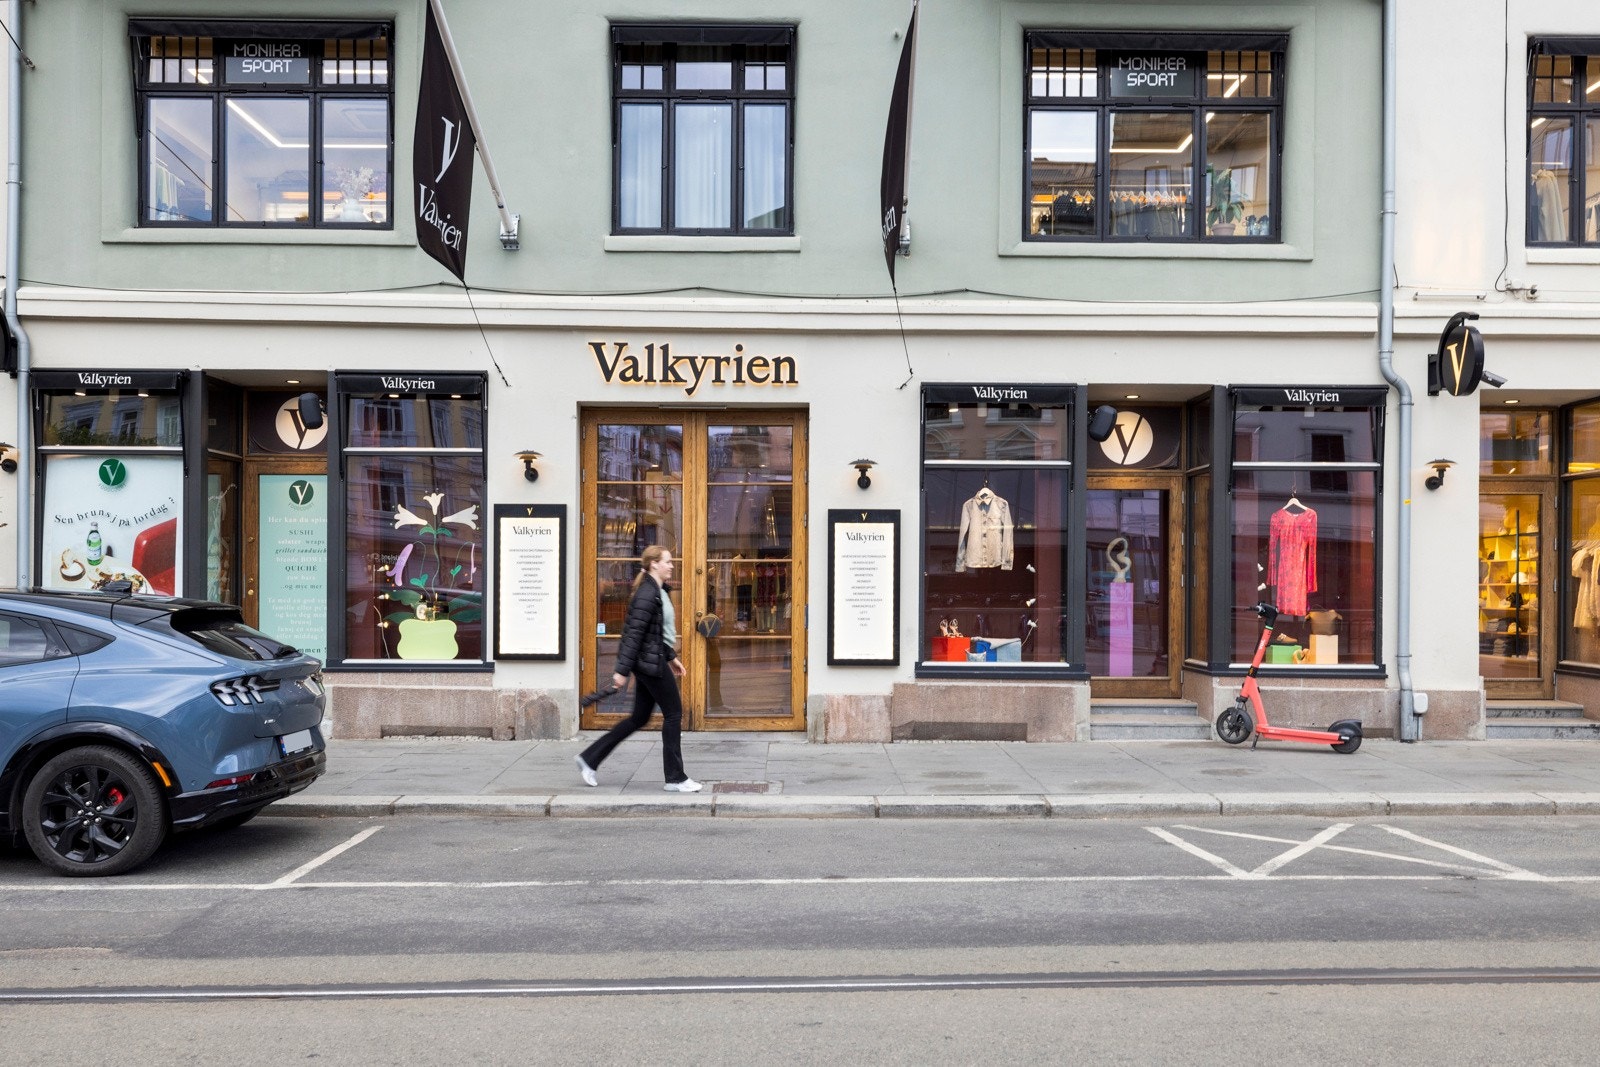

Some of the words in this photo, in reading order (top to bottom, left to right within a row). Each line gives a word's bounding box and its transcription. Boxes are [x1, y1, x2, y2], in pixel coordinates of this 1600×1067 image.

[233, 43, 301, 57] MONIKER
[242, 59, 292, 73] SPORT
[1118, 57, 1186, 70] MONIKER
[1127, 73, 1177, 86] SPORT
[588, 341, 799, 396] Valkyrien
[77, 372, 132, 388] Valkyrien
[381, 376, 435, 392] Valkyrien
[972, 386, 1028, 402] Valkyrien
[1283, 389, 1340, 405] Valkyrien
[512, 526, 552, 538] Valkyrien
[846, 532, 885, 544] Valkyrien
